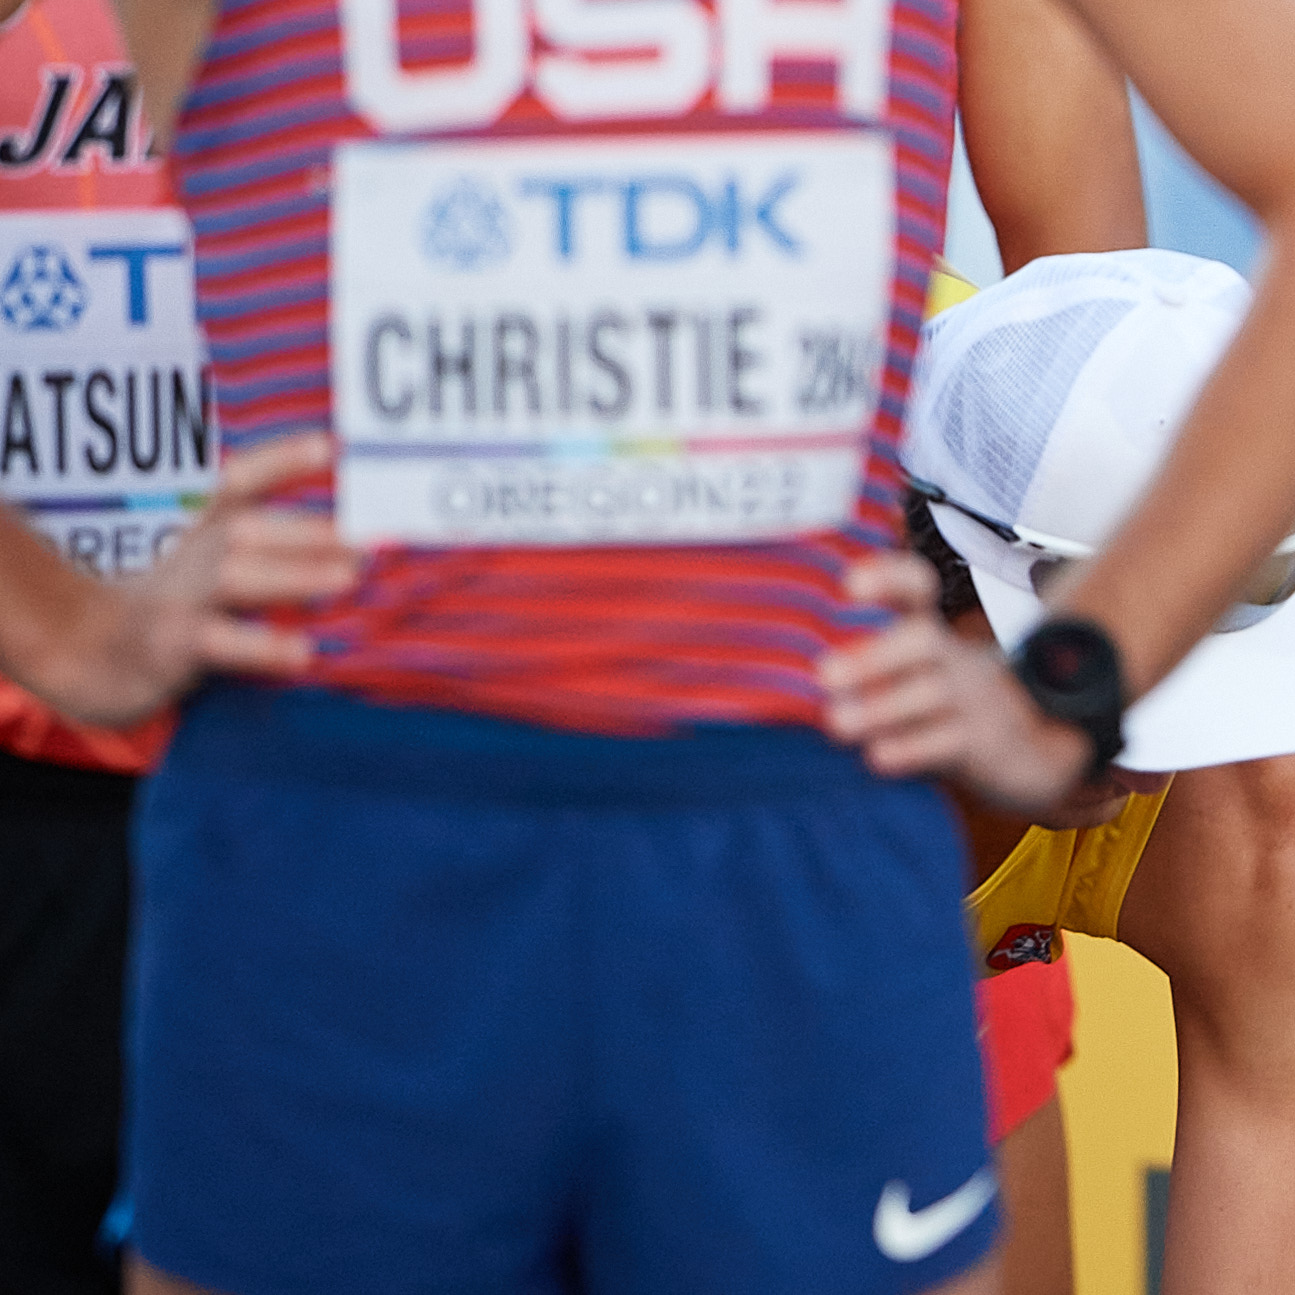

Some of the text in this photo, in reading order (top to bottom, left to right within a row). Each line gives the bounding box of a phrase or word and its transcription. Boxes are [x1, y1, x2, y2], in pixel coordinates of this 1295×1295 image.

[0, 74, 157, 167] JA
[521, 170, 806, 262] TDK
[362, 308, 766, 422] CHRISTIE
